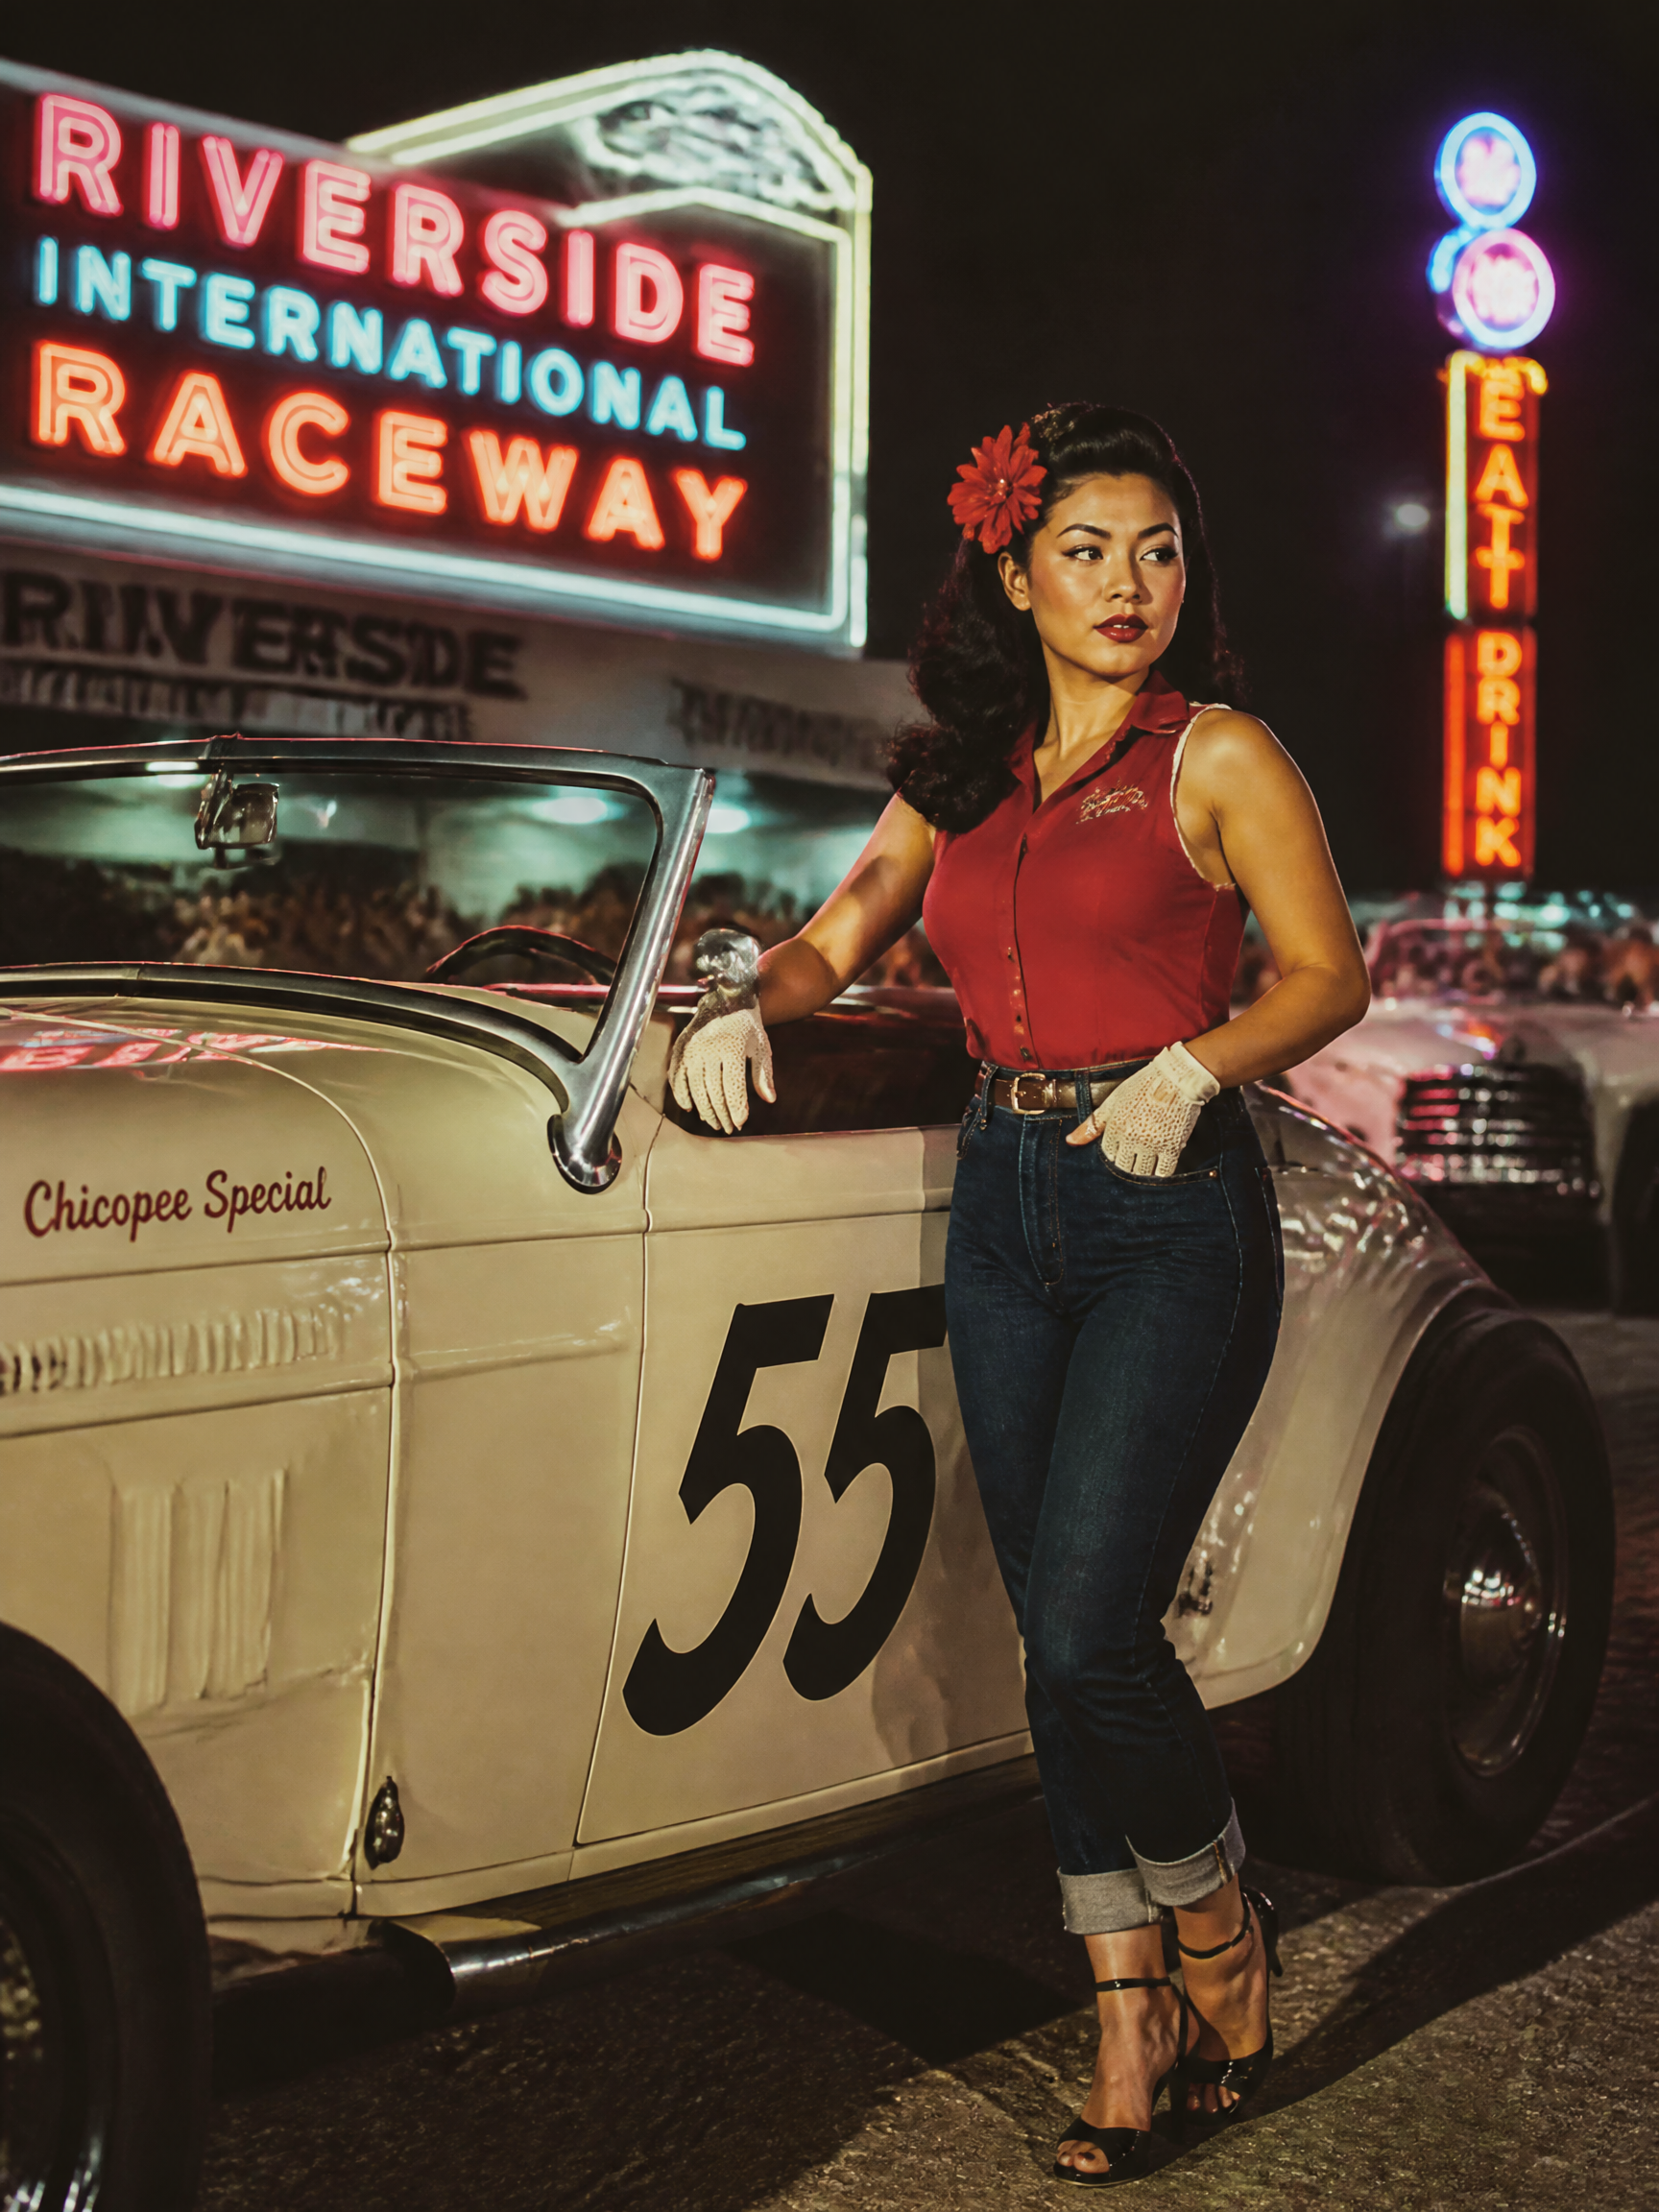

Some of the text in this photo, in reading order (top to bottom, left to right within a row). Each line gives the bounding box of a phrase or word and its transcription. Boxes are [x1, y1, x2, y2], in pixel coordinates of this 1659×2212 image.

[35, 93, 755, 367] RIVERSIDE
[36, 236, 747, 449] INTERNATIONAL
[33, 340, 748, 561] RACEWAY
[1474, 359, 1529, 867] EAT DRINK
[24, 1166, 331, 1242] Chicopee Special
[622, 1283, 948, 1736] 55
